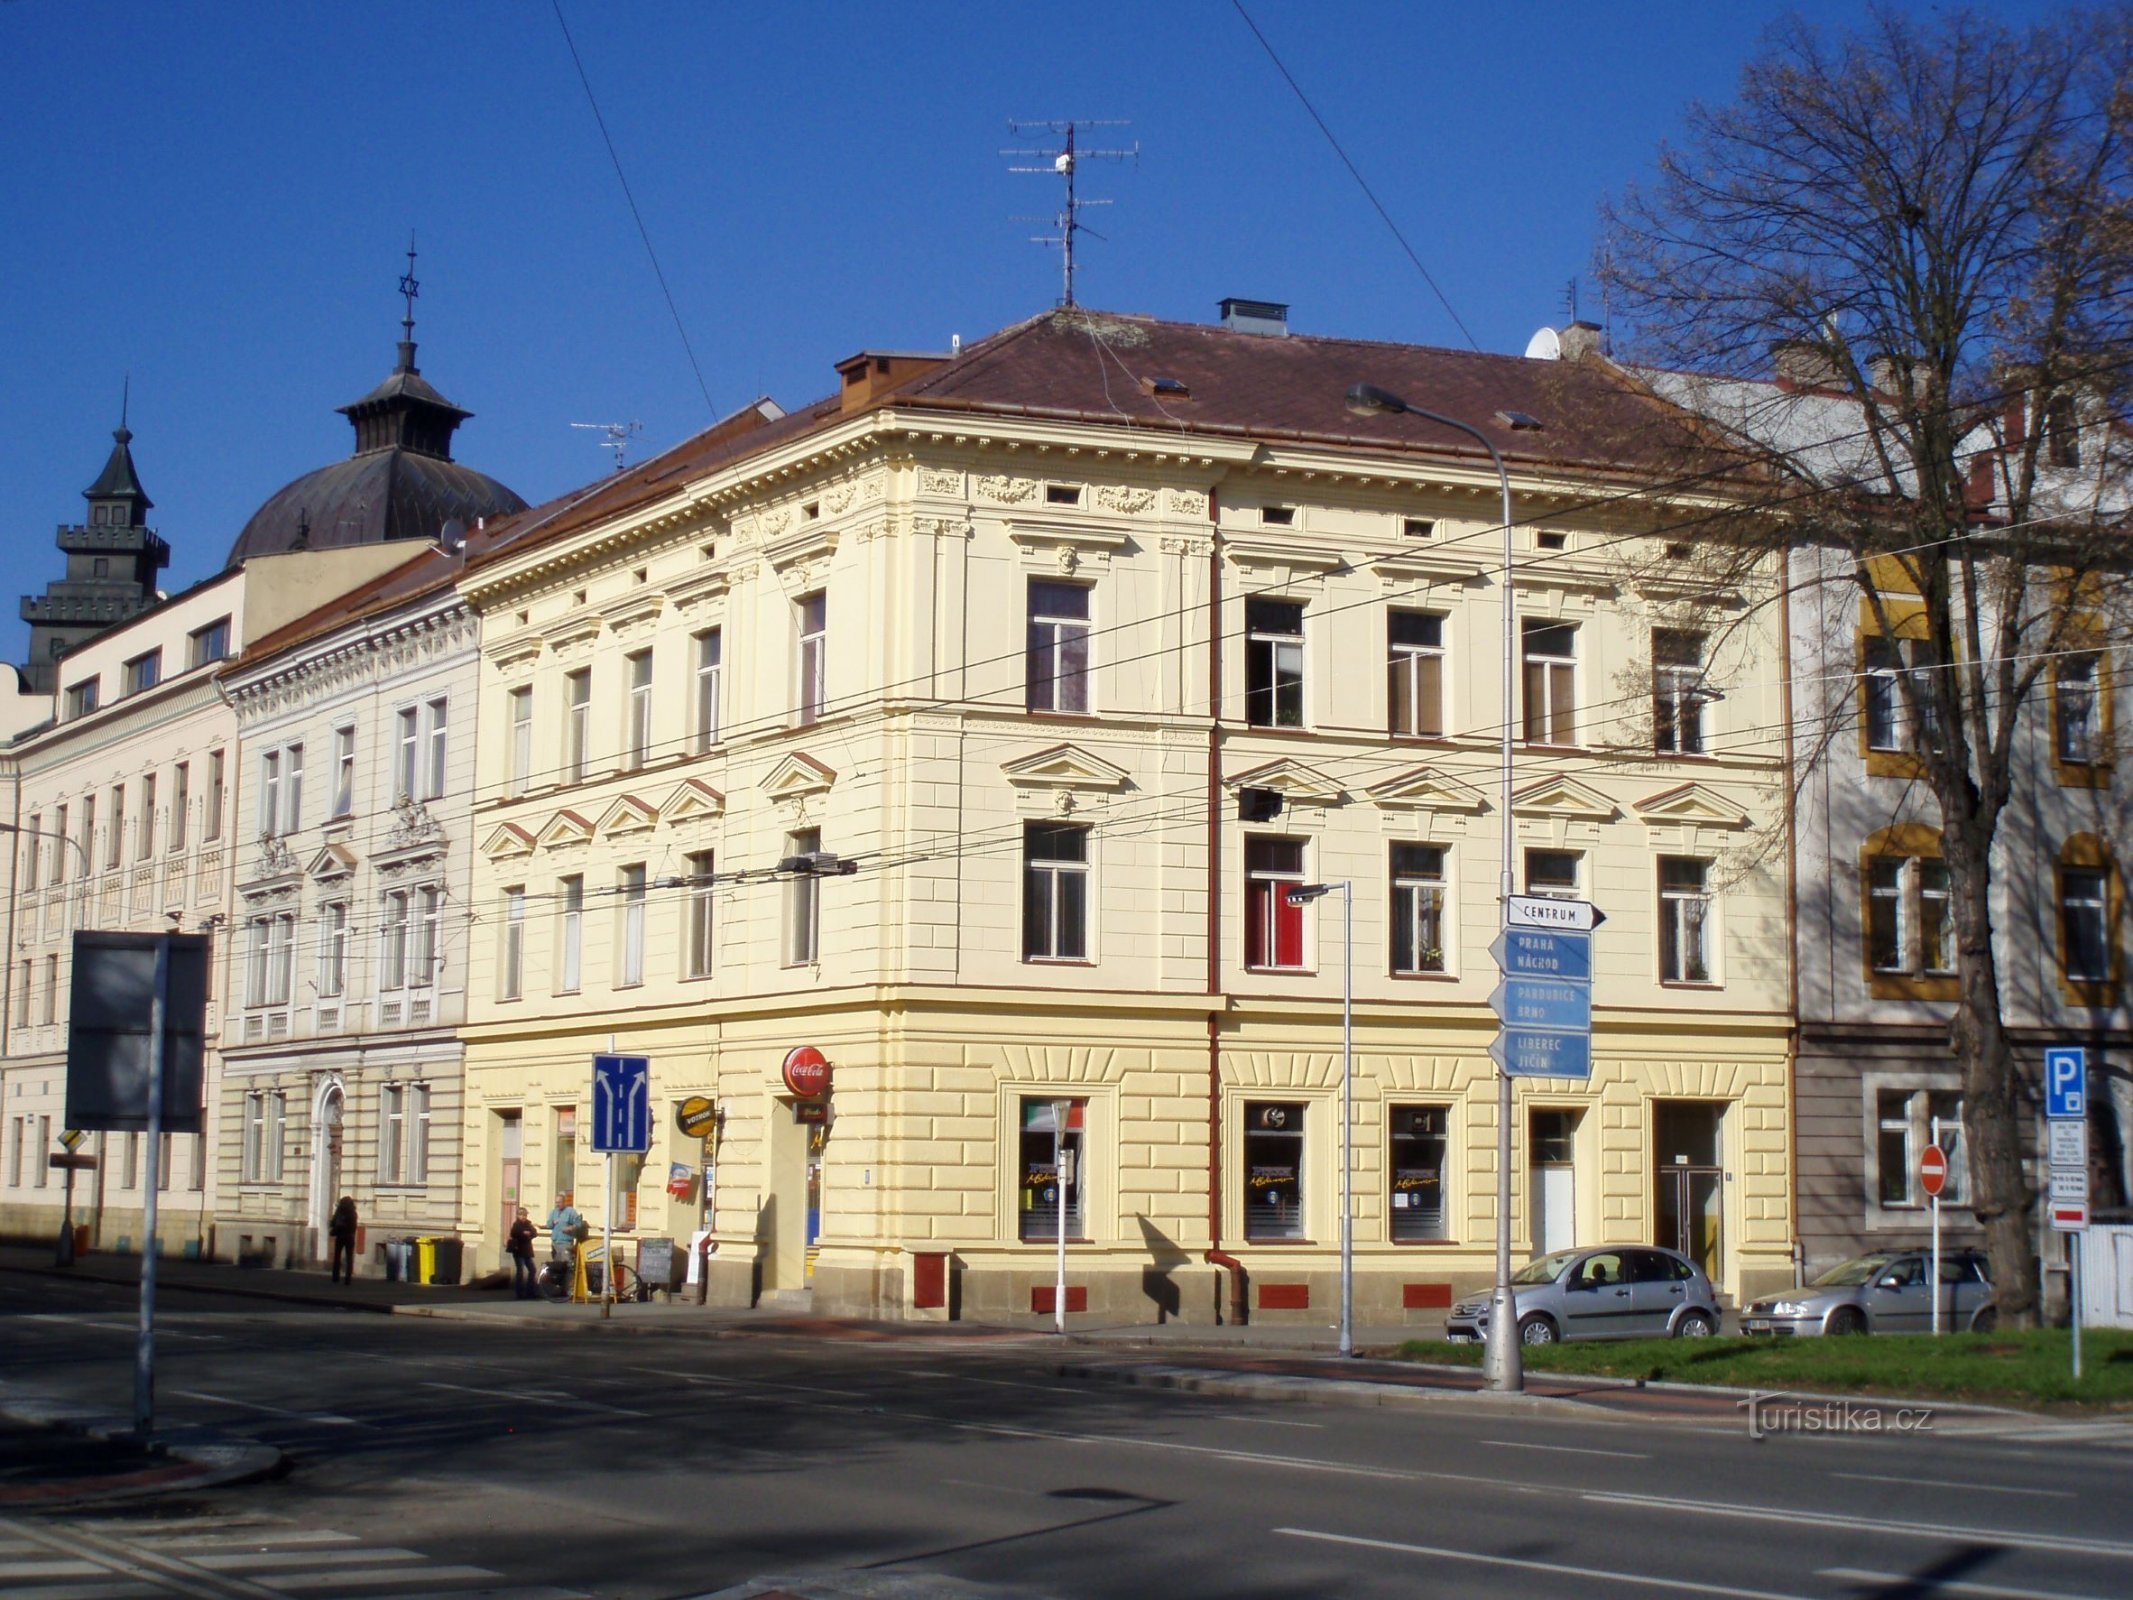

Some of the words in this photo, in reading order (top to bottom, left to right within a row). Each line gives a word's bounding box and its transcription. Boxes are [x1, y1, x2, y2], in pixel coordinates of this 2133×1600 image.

[1524, 905, 1575, 921] CENTRUM
[1518, 937, 1554, 951] PRAHA
[1517, 953, 1559, 970] NÁCHOD
[1518, 987, 1576, 1002] PARDUBICE
[1517, 1005, 1545, 1019] BRNO
[1517, 1036, 1561, 1051] LIBEREC
[1518, 1053, 1548, 1068] JIČÍN
[2054, 1057, 2077, 1096] P
